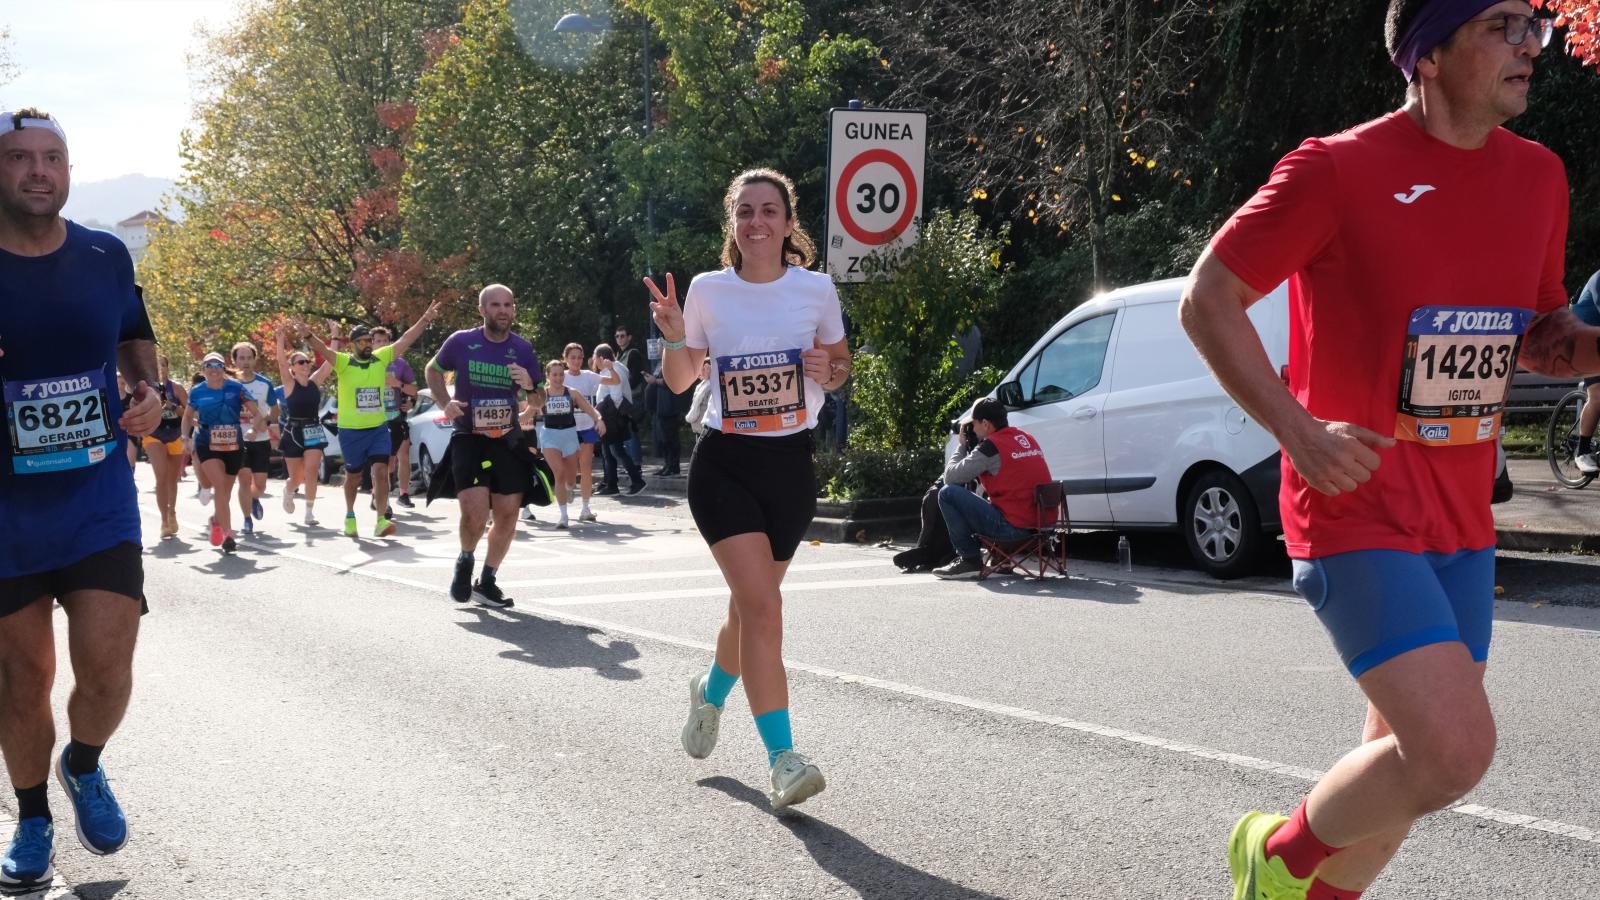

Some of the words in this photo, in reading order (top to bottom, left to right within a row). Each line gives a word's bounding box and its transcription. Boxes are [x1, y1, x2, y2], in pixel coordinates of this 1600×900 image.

[845, 122, 913, 140] GUNEA
[856, 183, 900, 213] 30
[1421, 345, 1511, 379] 14283
[728, 370, 795, 396] 15337
[748, 397, 779, 407] BEATRIZ
[1448, 389, 1481, 401] IGITOA
[18, 395, 101, 431] 6822
[476, 408, 511, 420] 14837
[39, 428, 91, 444] GERARD
